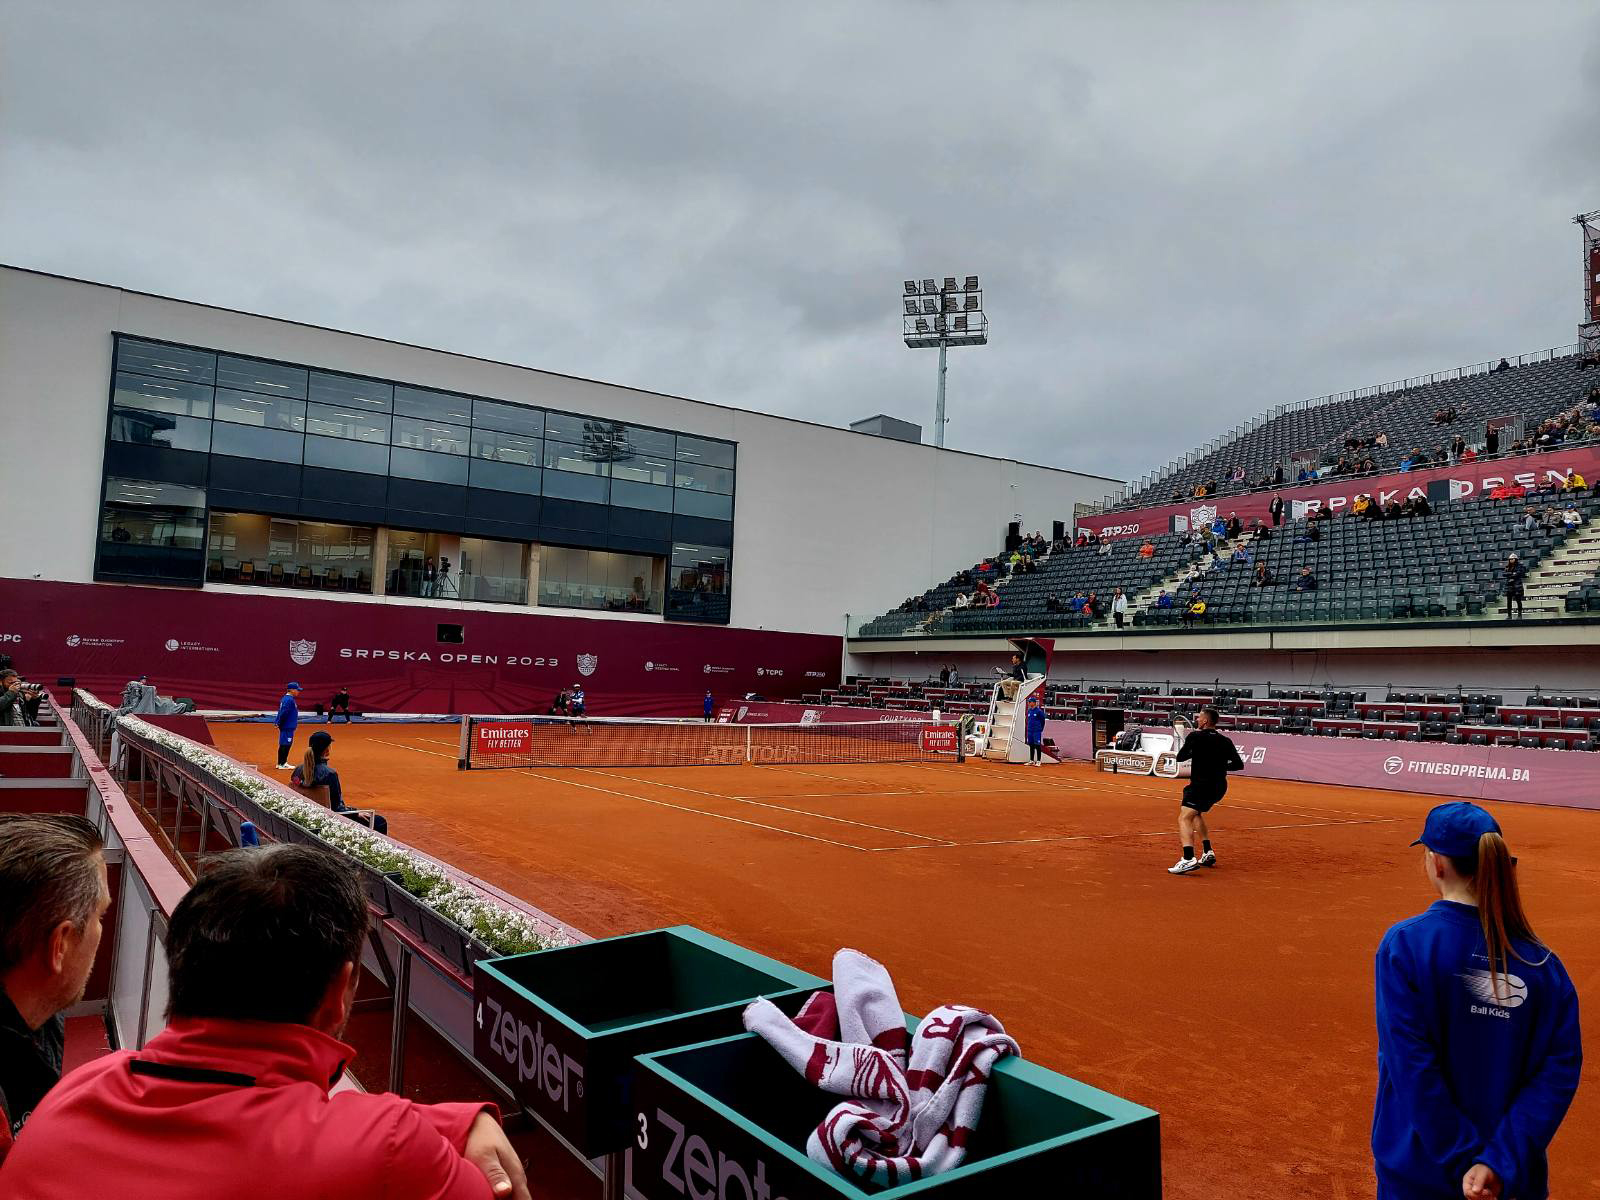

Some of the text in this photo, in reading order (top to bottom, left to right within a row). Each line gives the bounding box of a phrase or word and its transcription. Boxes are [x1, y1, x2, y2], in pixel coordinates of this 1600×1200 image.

[0, 634, 22, 643] PC
[340, 648, 559, 667] SRPSKA OPEN 2023
[481, 727, 529, 739] Emirates
[925, 730, 954, 739] Emirates
[487, 739, 521, 749] FLY BETTER
[1103, 756, 1146, 768] waterdrop
[1408, 760, 1530, 782] FITNESOPREMA.BA
[476, 1002, 483, 1029] 4
[1470, 1005, 1510, 1019] Ball Kids
[637, 1112, 649, 1150] 3
